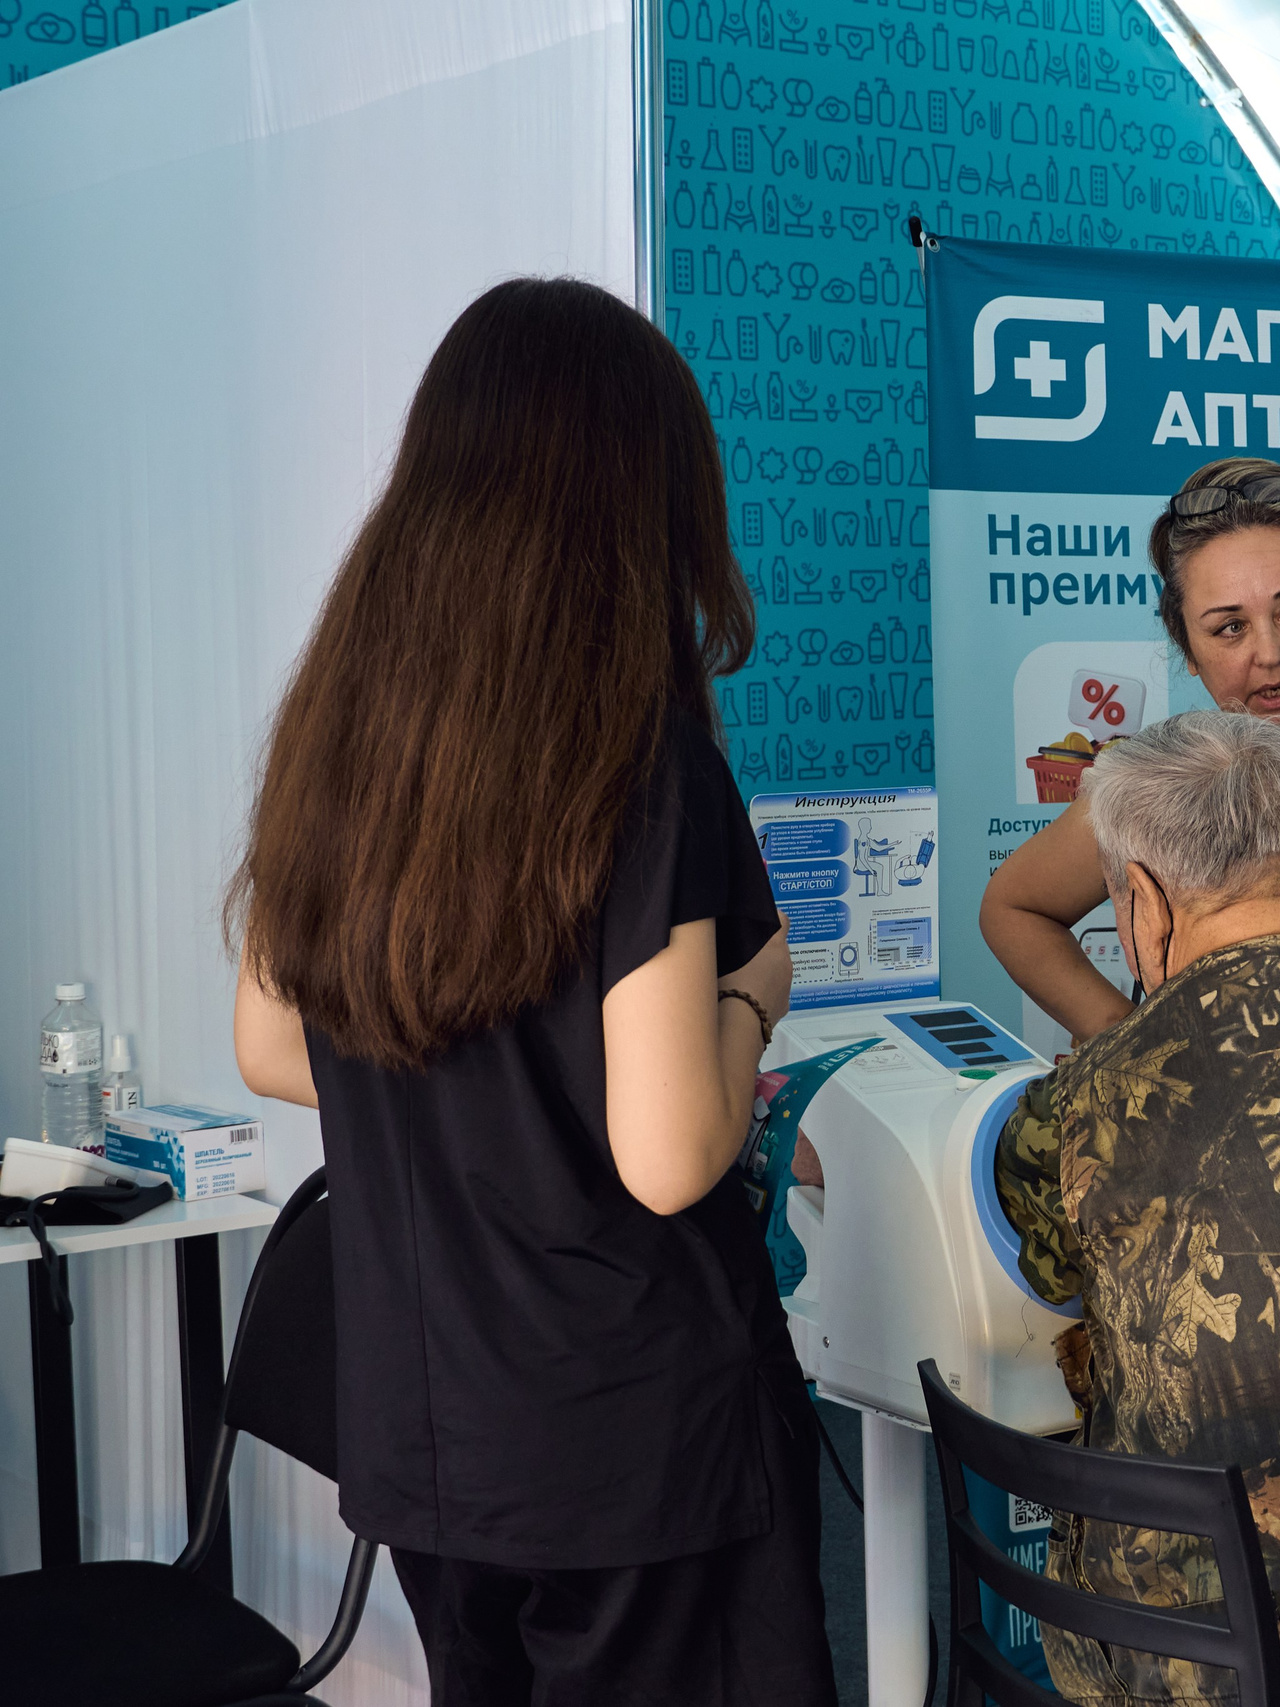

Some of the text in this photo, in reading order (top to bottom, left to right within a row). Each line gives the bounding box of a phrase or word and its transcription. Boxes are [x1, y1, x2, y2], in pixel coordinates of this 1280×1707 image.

[987, 513, 1131, 558] Наши
[795, 794, 896, 808] Инструкция
[988, 818, 1055, 836] Доступ
[758, 833, 768, 850] 1
[773, 869, 839, 880] Нажмите кнопку
[780, 879, 833, 891] СТАРТ/СТОП
[195, 1148, 225, 1158] ШПАТЕЛЬ
